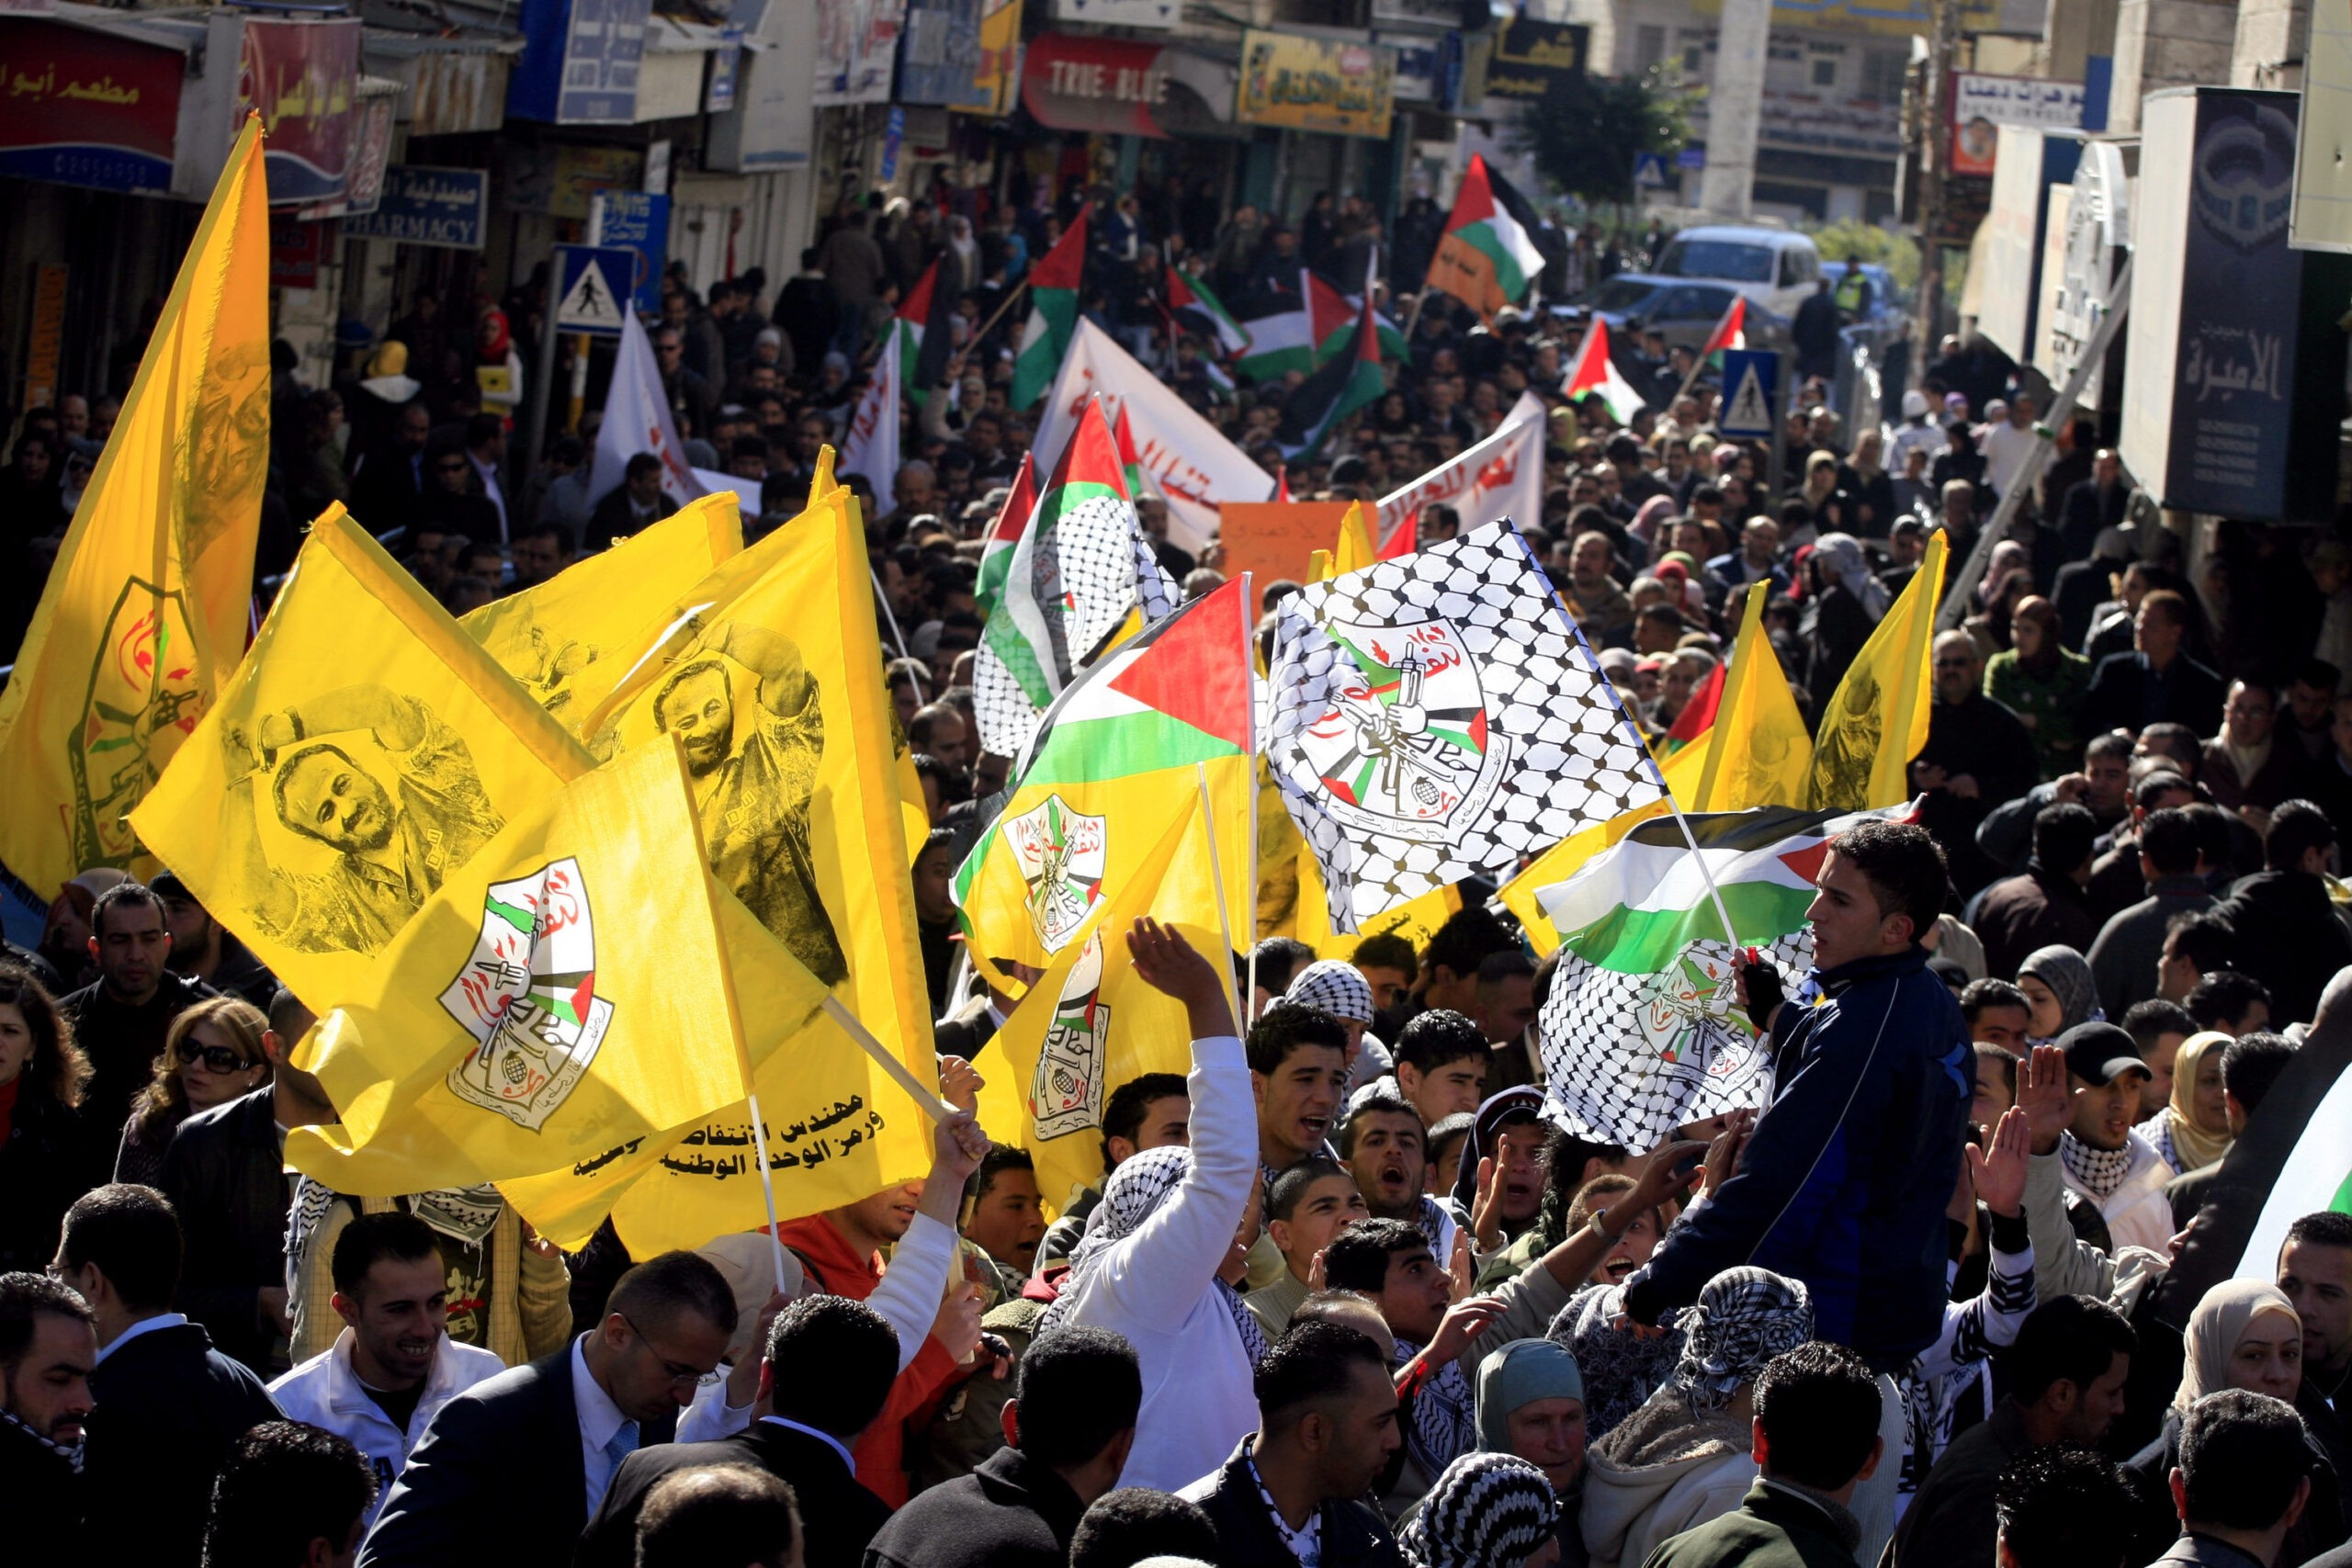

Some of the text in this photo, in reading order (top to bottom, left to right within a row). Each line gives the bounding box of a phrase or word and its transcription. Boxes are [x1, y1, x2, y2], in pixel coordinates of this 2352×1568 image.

[56, 75, 141, 105] مطعم
[1047, 59, 1171, 105] TRUE BLUE
[404, 171, 478, 211] صيدلية
[342, 213, 475, 243] PHARMACY
[780, 1094, 864, 1144] مهندس
[834, 1111, 885, 1157] ورمز
